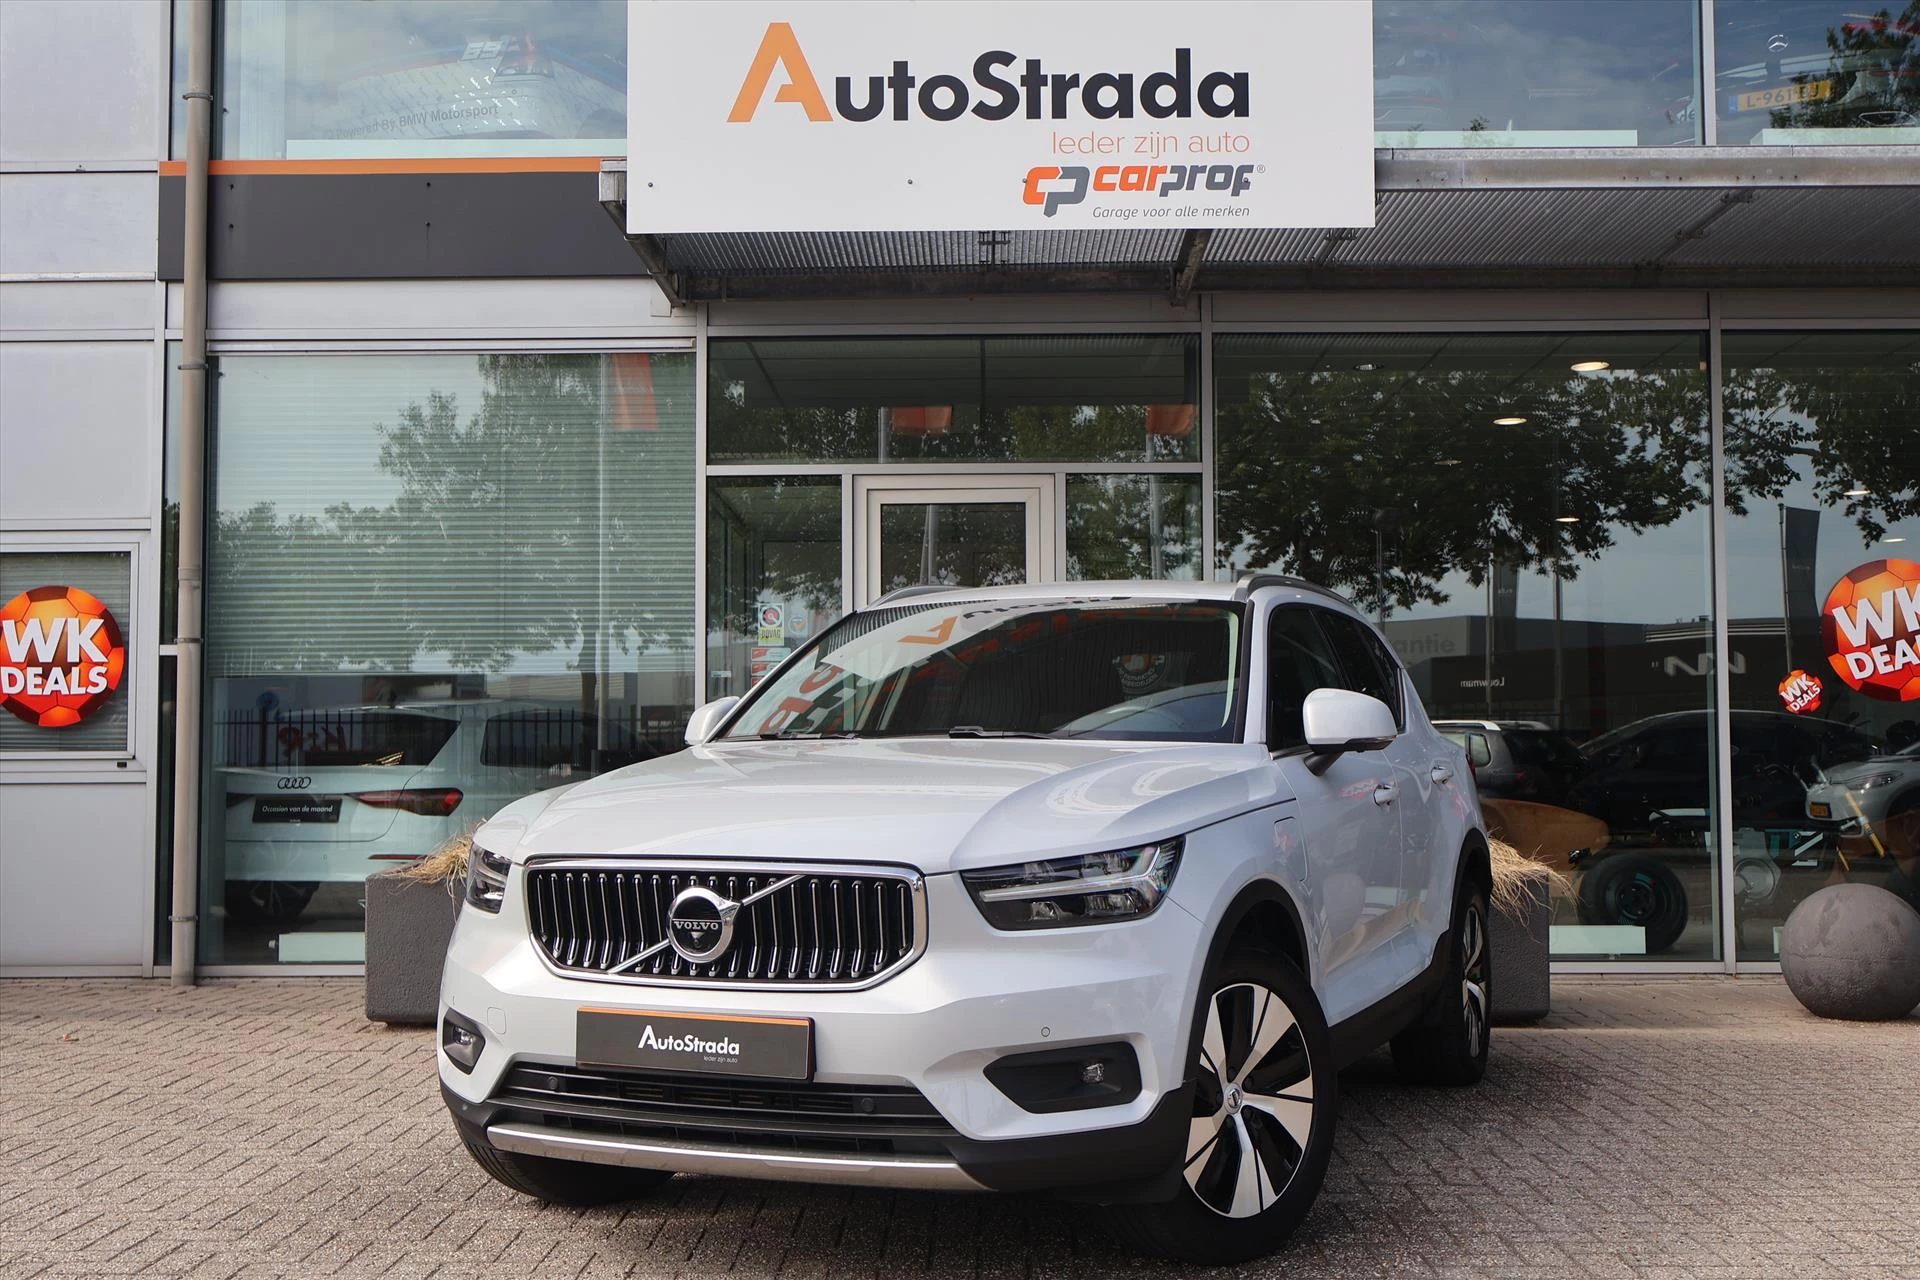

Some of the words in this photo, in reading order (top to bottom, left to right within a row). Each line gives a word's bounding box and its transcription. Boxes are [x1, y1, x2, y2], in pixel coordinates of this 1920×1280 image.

[727, 22, 1250, 122] AutoStrada
[399, 111, 428, 127] BMW
[430, 104, 499, 122] Motorsport
[1052, 131, 1125, 154] Ieder
[1134, 132, 1179, 159] zijn
[1188, 131, 1250, 153] auto
[1092, 206, 1138, 221] Garage
[1142, 208, 1170, 218] voor
[1175, 206, 1199, 217] alle
[1202, 205, 1250, 217] merken
[1832, 583, 1920, 647] WK
[2, 617, 108, 663] WK
[1845, 635, 1920, 680] DEA
[0, 665, 108, 695] DEALS
[1780, 673, 1814, 702] WK
[1790, 683, 1821, 712] DEALS
[262, 805, 289, 813] Occasion
[301, 805, 310, 813] de
[674, 921, 719, 930] VOLVO
[638, 1025, 740, 1056] AutoStrada
